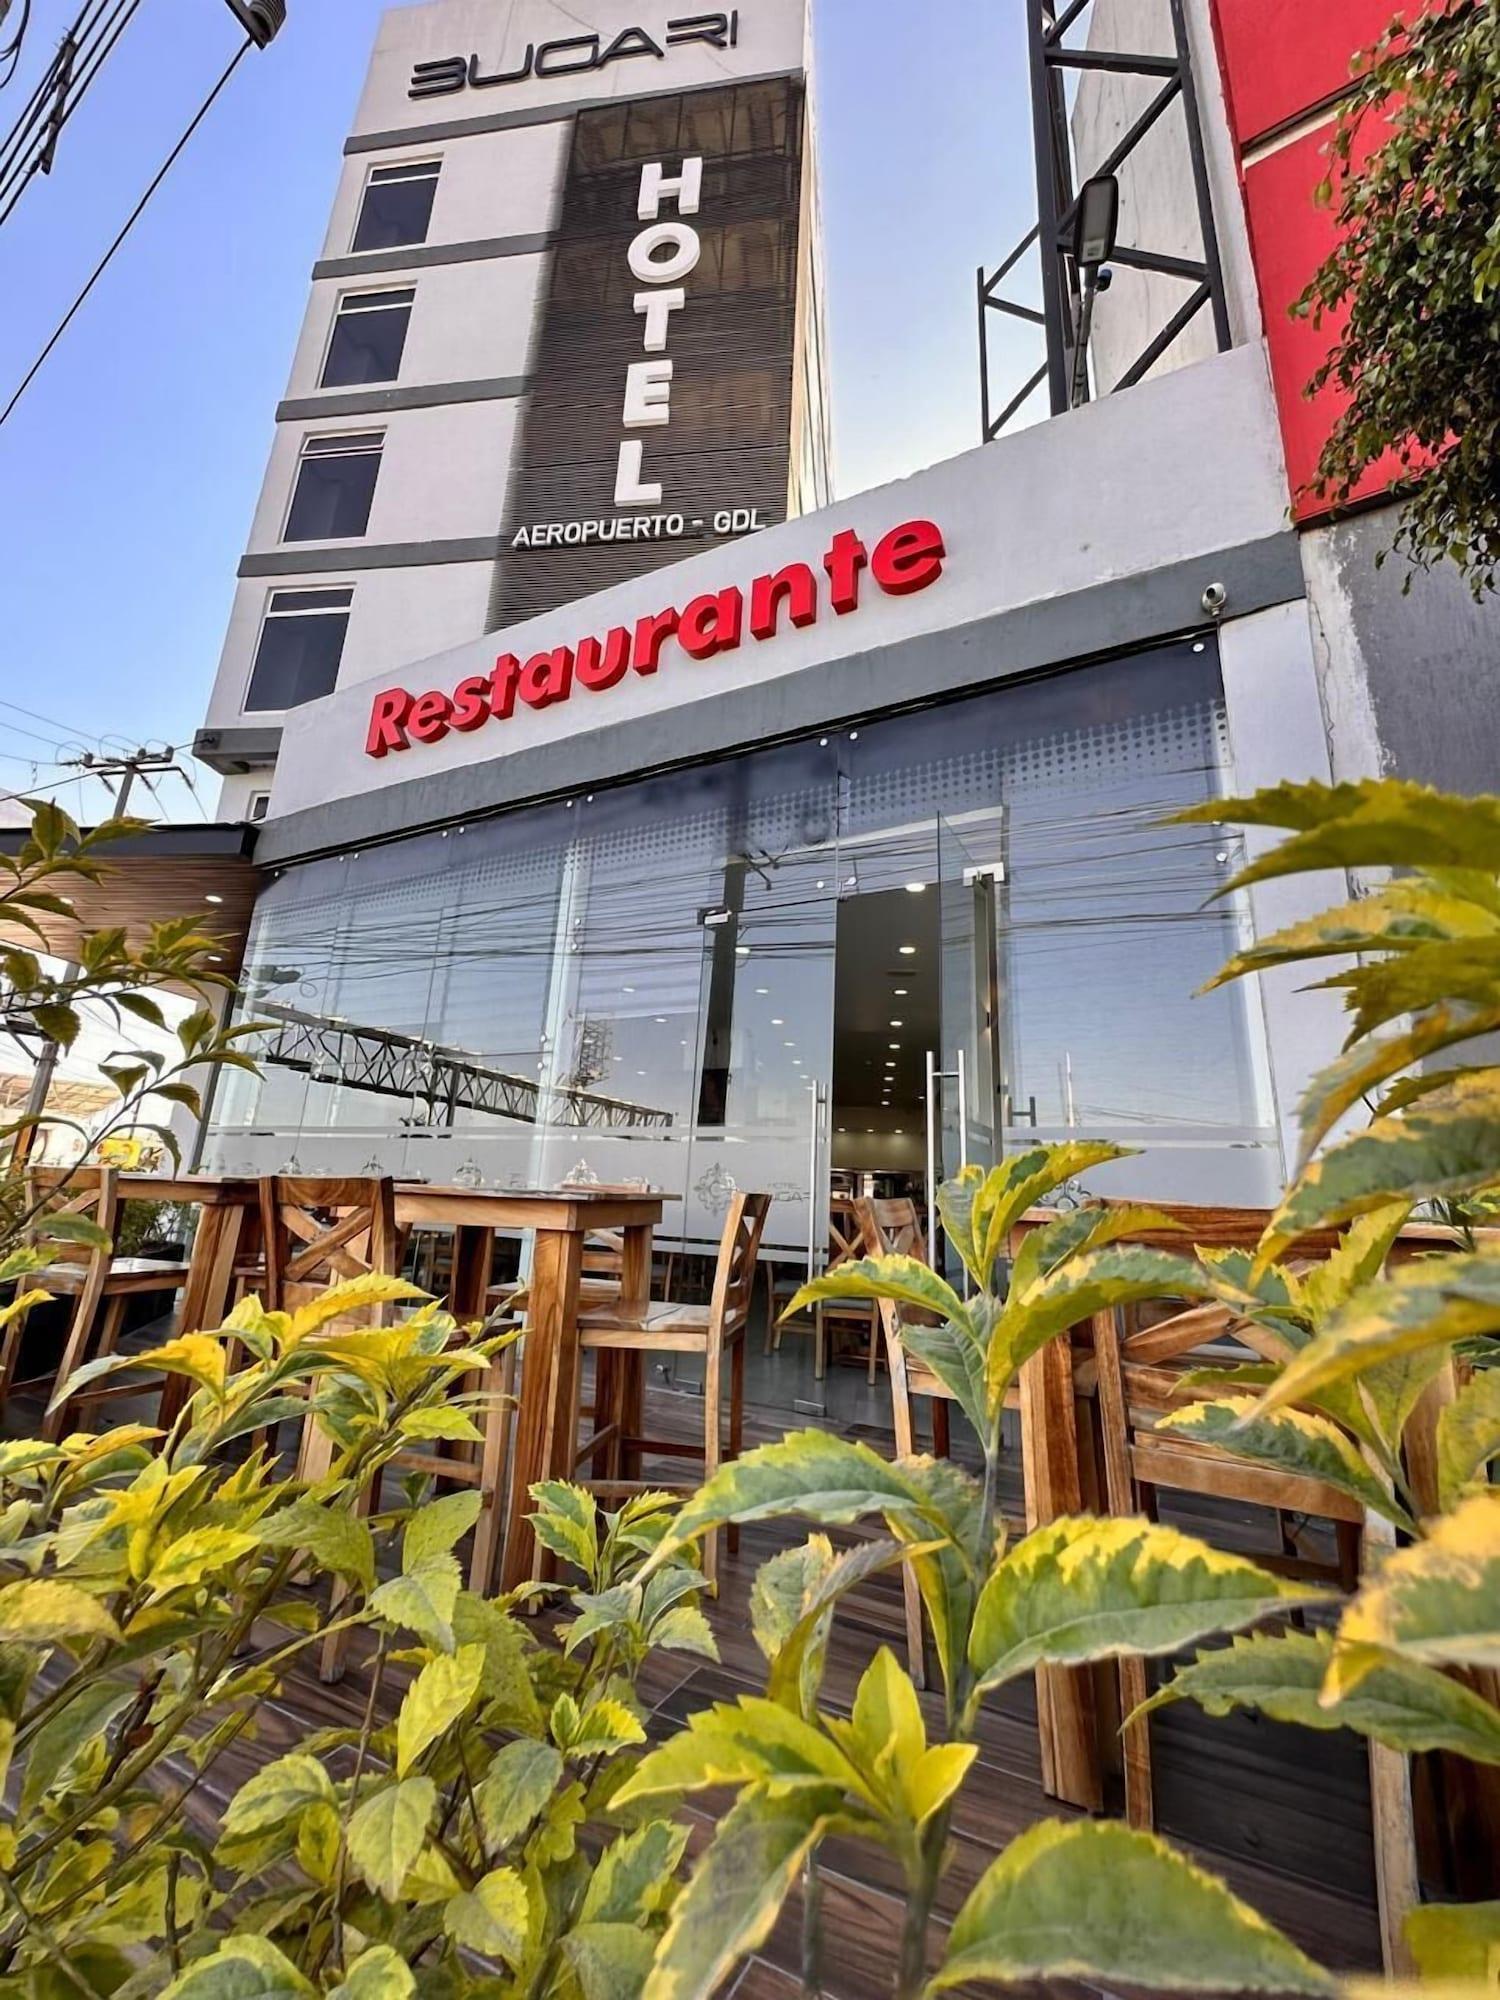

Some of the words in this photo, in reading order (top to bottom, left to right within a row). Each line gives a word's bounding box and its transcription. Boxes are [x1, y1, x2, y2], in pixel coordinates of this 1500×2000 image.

[612, 157, 703, 507] HOTEL
[365, 520, 947, 758] Restaurante
[511, 513, 684, 548] AEROPUERTO
[713, 508, 767, 533] GDL
